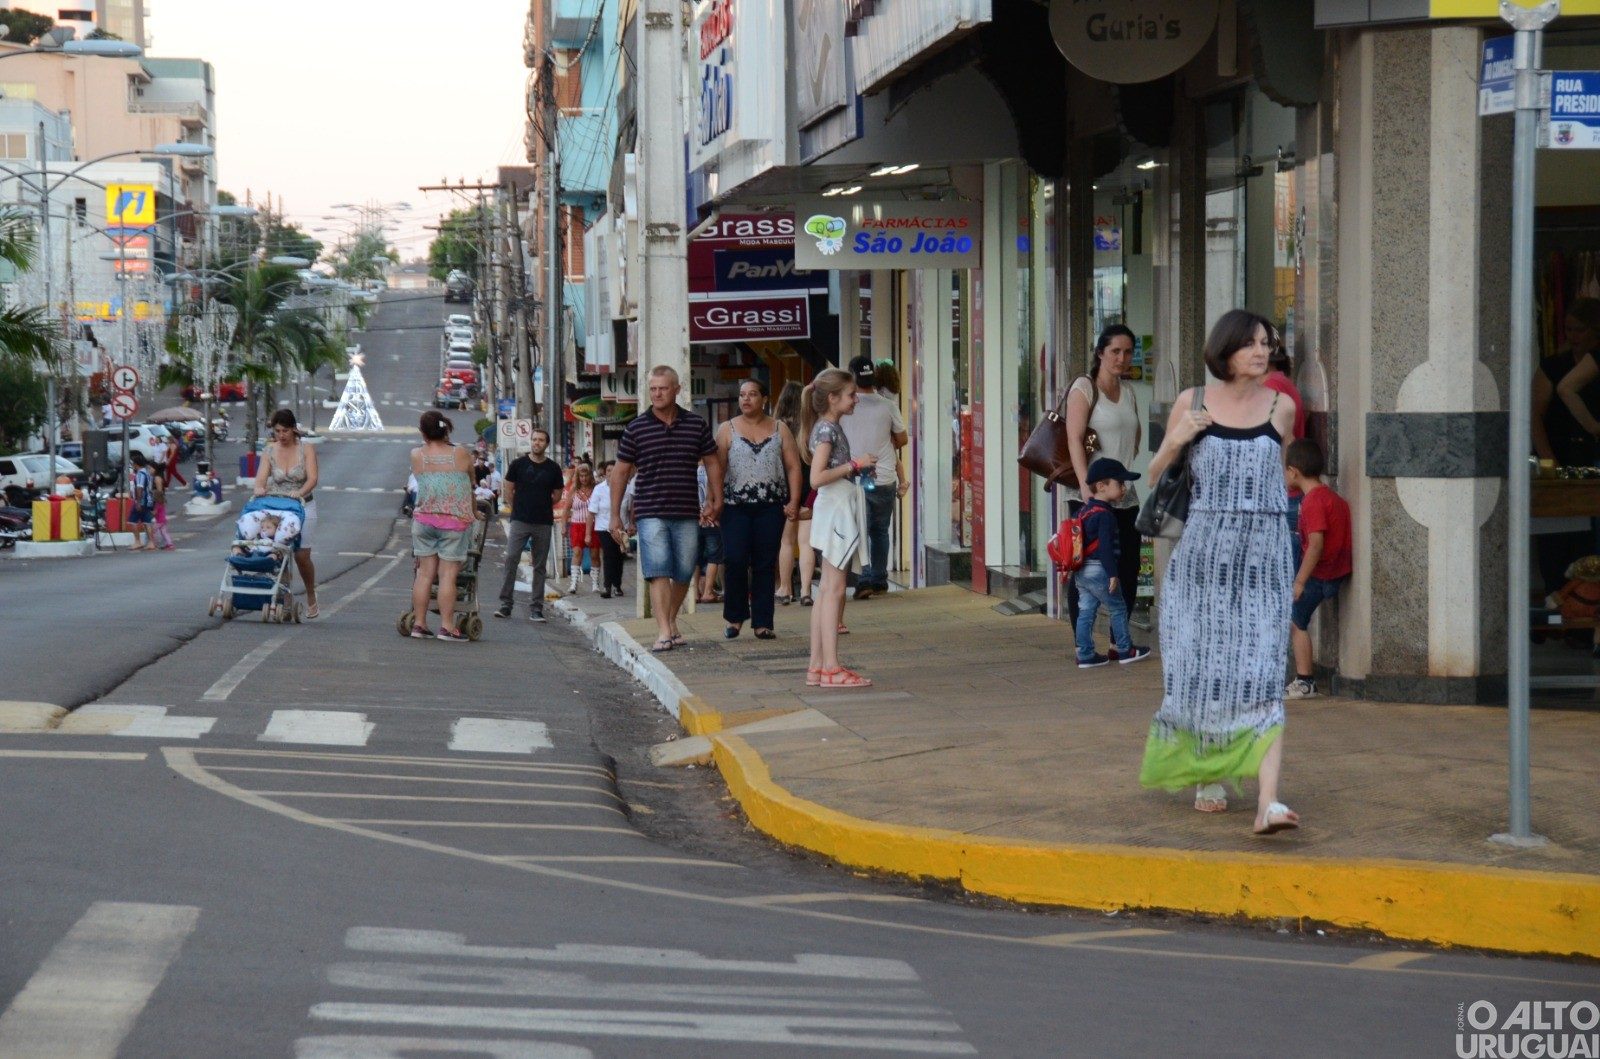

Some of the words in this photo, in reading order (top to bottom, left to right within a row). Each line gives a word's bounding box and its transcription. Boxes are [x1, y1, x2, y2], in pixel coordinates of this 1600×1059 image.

[1556, 79, 1583, 93] RUA
[700, 218, 795, 238] Grass
[861, 216, 970, 229] FARMÁCIAS
[853, 231, 903, 254] São
[910, 231, 973, 254] João
[706, 305, 801, 326] Grassi
